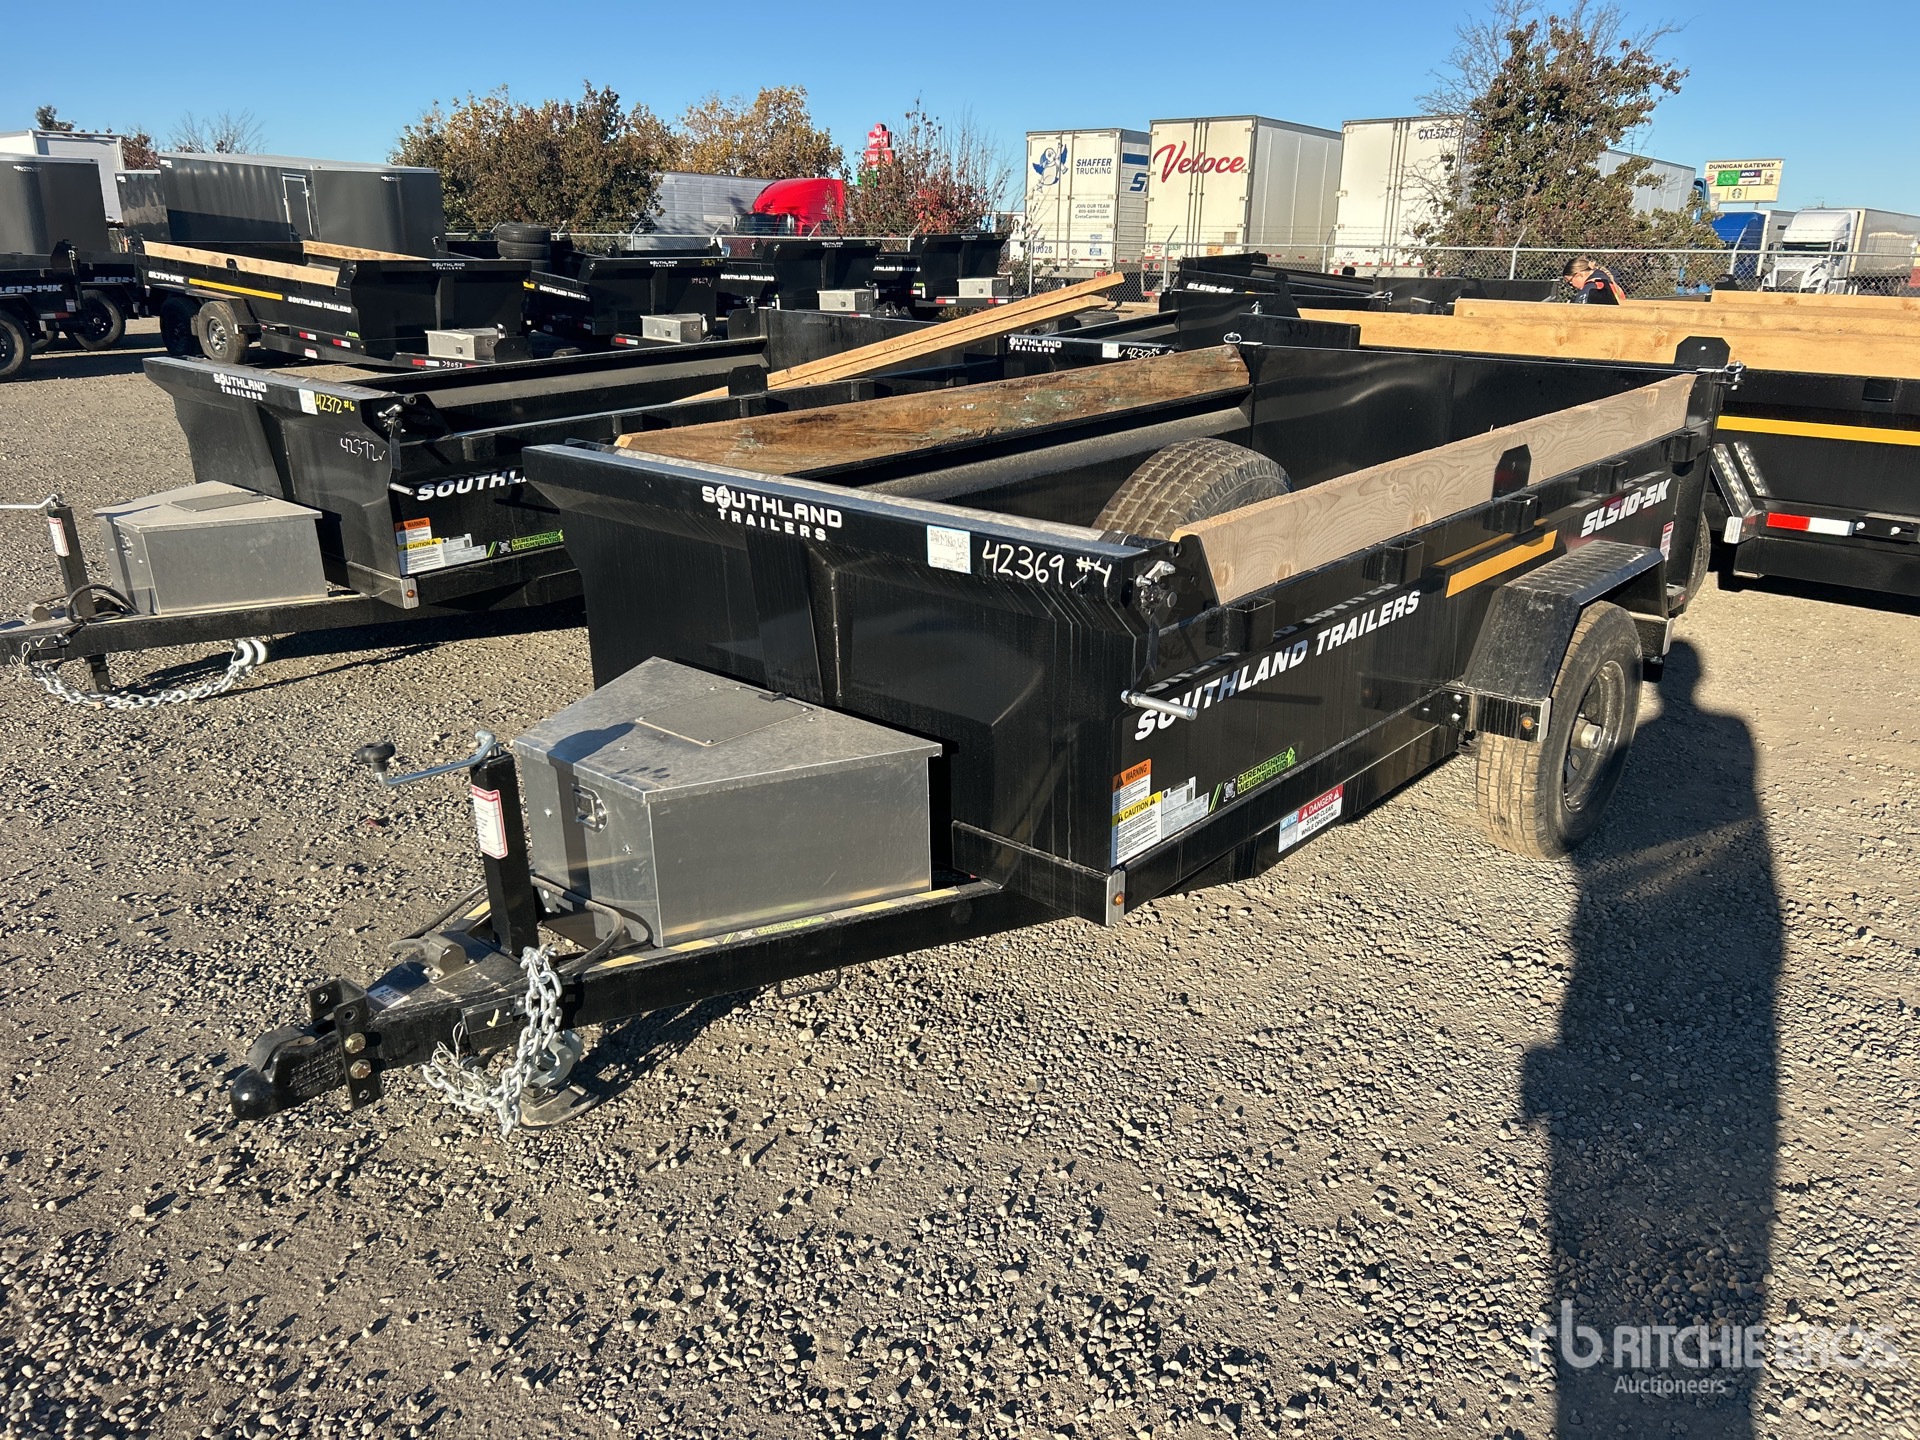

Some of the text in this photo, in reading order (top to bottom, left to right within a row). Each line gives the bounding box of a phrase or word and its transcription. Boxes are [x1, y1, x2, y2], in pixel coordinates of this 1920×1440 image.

[1076, 158, 1112, 167] SHAFFER
[1076, 167, 1112, 175] TRUCKING
[1153, 141, 1246, 183] Veloce
[720, 273, 775, 282] SOUTHLAND TRAILERS
[539, 284, 568, 297] SOUTHLAND
[288, 295, 352, 314] SOUTHLAND TRAILERS
[1009, 345, 1056, 354] TRAILERS
[213, 372, 267, 393] SOUTHLAND
[220, 385, 263, 401] TRAILERS
[315, 393, 343, 415] 42372
[702, 485, 843, 529] SOUTHLAND
[407, 519, 428, 528] WARNING
[717, 508, 827, 541] TRAILERS
[408, 540, 431, 550] CAUTION
[982, 540, 1065, 584] 42369
[1076, 556, 1112, 588] #4
[1134, 589, 1421, 741] SOUTHLAND TRAILERS
[1125, 763, 1148, 781] WARNING
[1238, 757, 1277, 785] STRENGTH
[1238, 760, 1287, 793] WEIGHT RATIO
[1124, 800, 1149, 819] CAUTION
[1306, 804, 1334, 826] STAND CLEAR
[1308, 794, 1333, 815] DANGER
[1301, 809, 1338, 836] WHILE OPERATING
